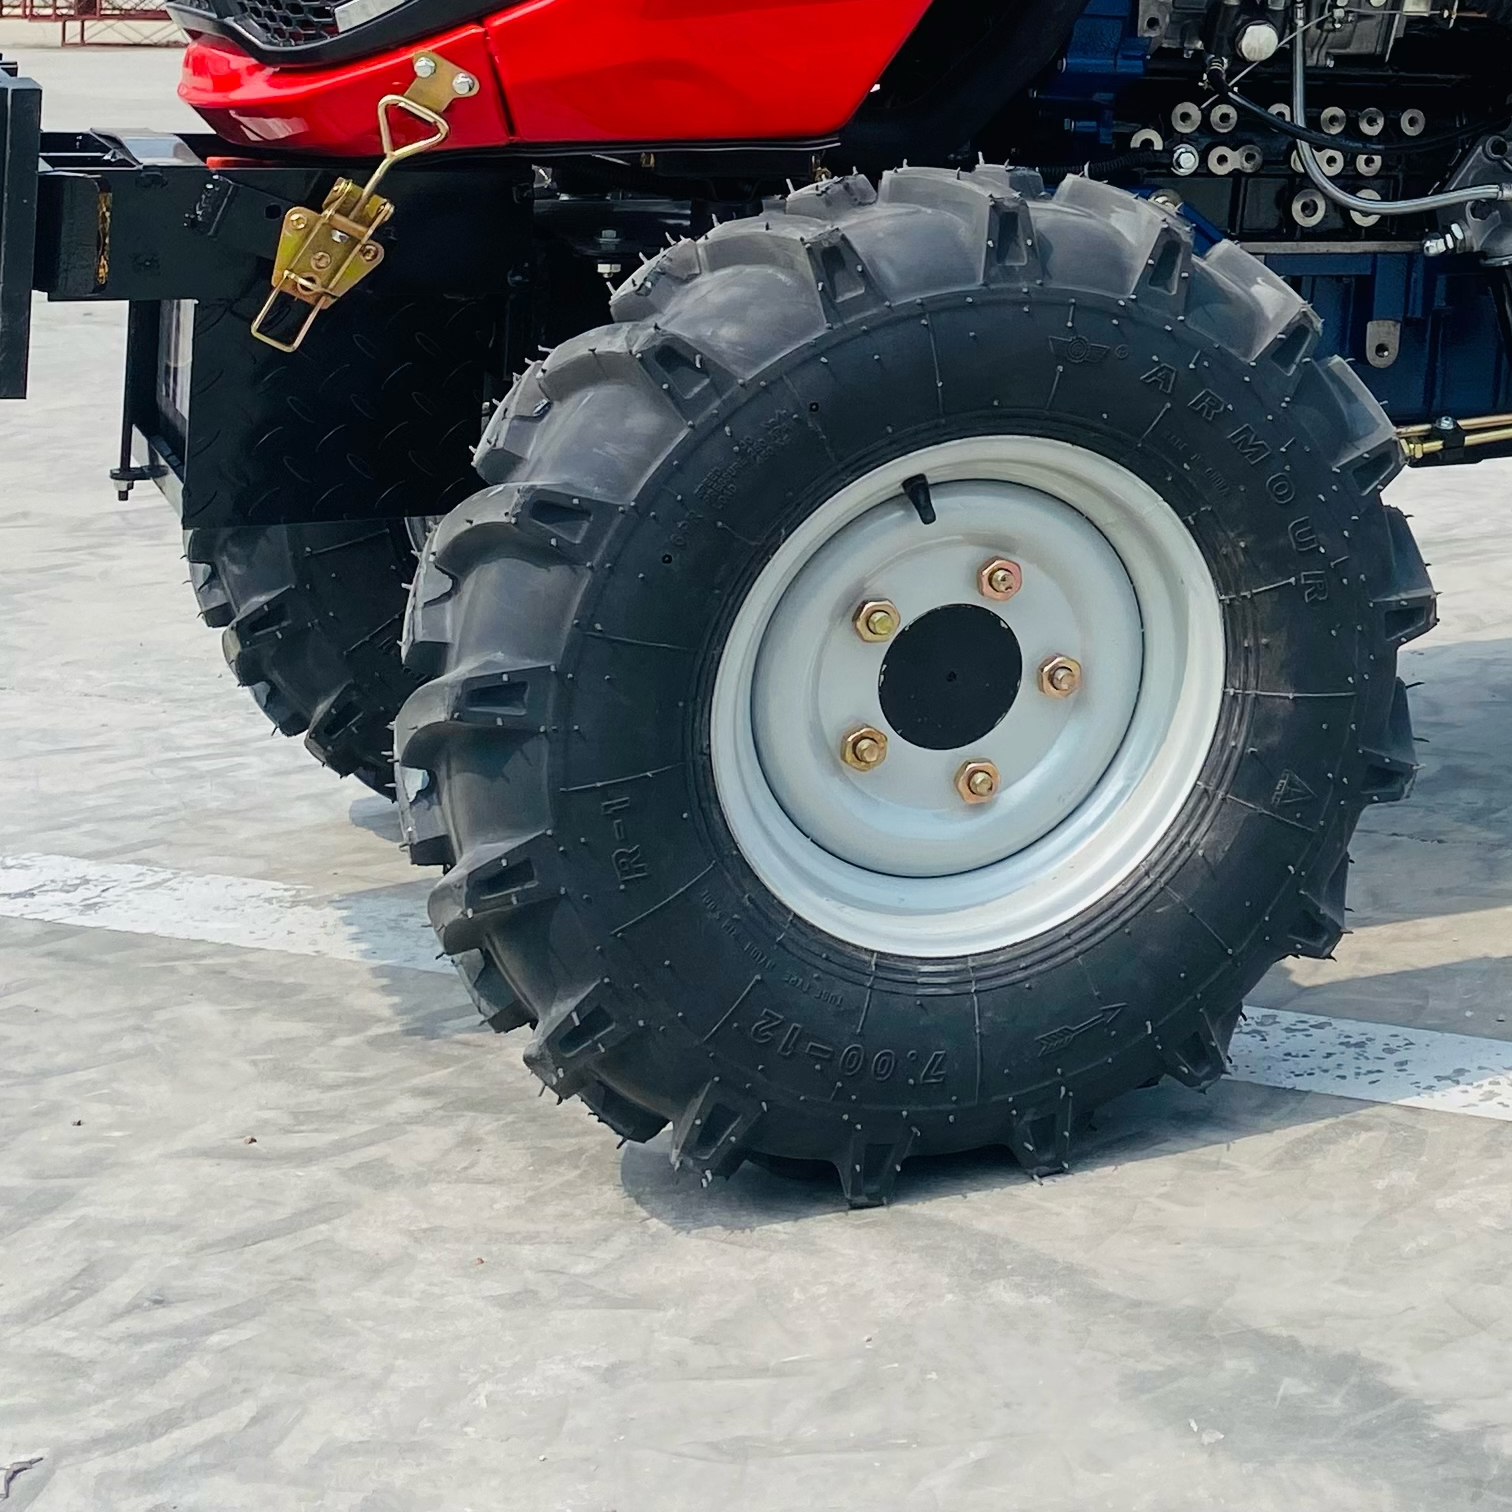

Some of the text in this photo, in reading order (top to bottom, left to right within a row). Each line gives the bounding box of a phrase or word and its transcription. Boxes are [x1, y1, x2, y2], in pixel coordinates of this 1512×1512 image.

[1140, 363, 1329, 603] ARMOUR
[601, 797, 649, 881] R-1
[752, 1008, 946, 1084] 7.00-12
